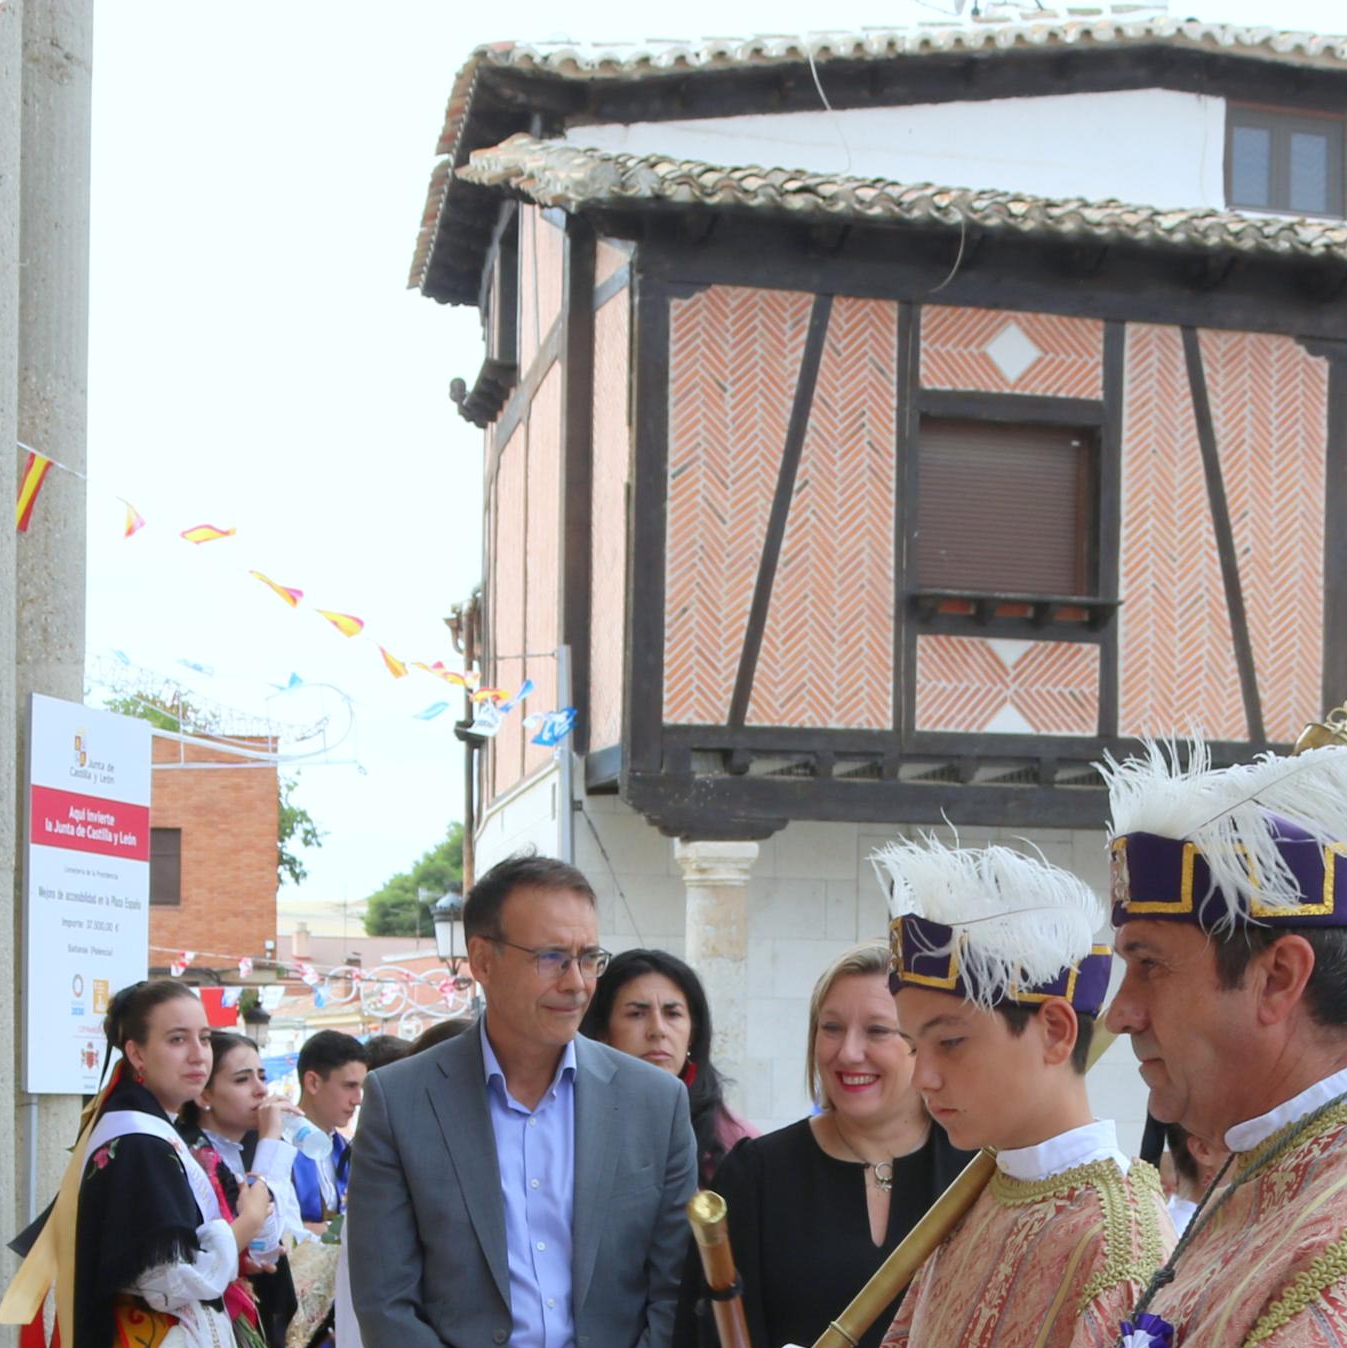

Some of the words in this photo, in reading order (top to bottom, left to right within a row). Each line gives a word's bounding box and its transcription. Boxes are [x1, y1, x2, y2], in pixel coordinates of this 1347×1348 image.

[88, 760, 105, 770] Junta
[107, 761, 115, 772] de
[70, 767, 92, 780] Castilla
[93, 773, 98, 784] y
[100, 772, 115, 784] León
[86, 808, 115, 826] invierte
[44, 817, 53, 832] la
[54, 819, 75, 836] Junta
[76, 822, 86, 838] de
[86, 824, 113, 842] Castilla
[113, 832, 119, 846] y
[119, 830, 137, 847] León
[57, 888, 63, 900] de
